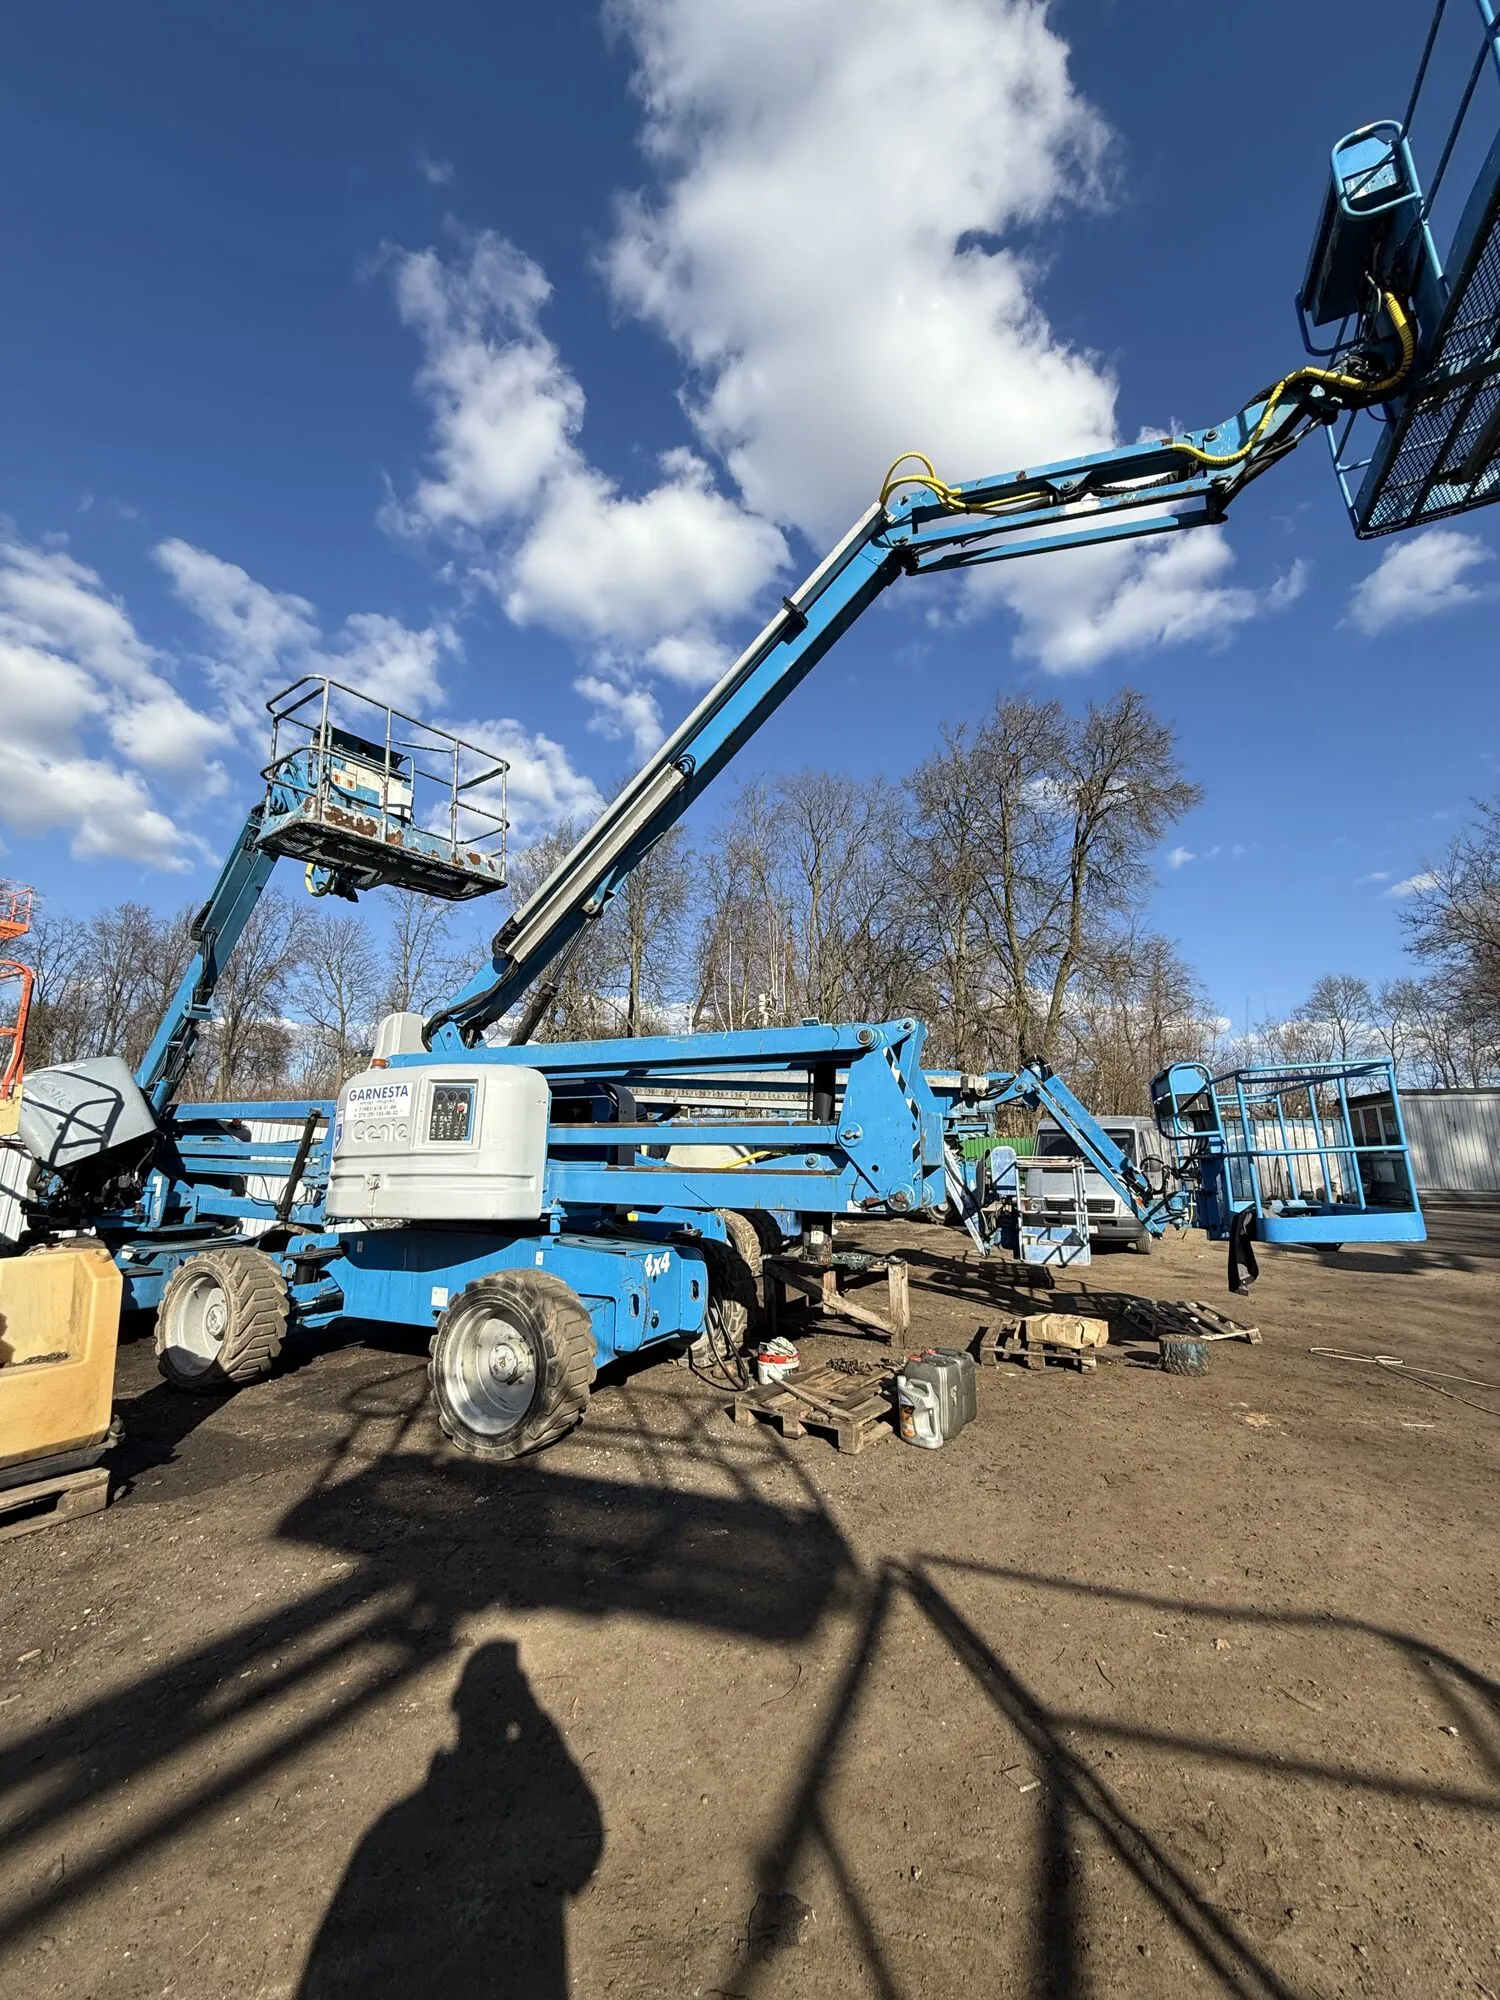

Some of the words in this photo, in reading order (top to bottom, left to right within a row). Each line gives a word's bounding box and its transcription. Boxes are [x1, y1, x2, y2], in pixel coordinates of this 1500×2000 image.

[349, 1085, 409, 1102] GARNESTA
[352, 1119, 409, 1143] Genie
[644, 1251, 671, 1277] 4x4
